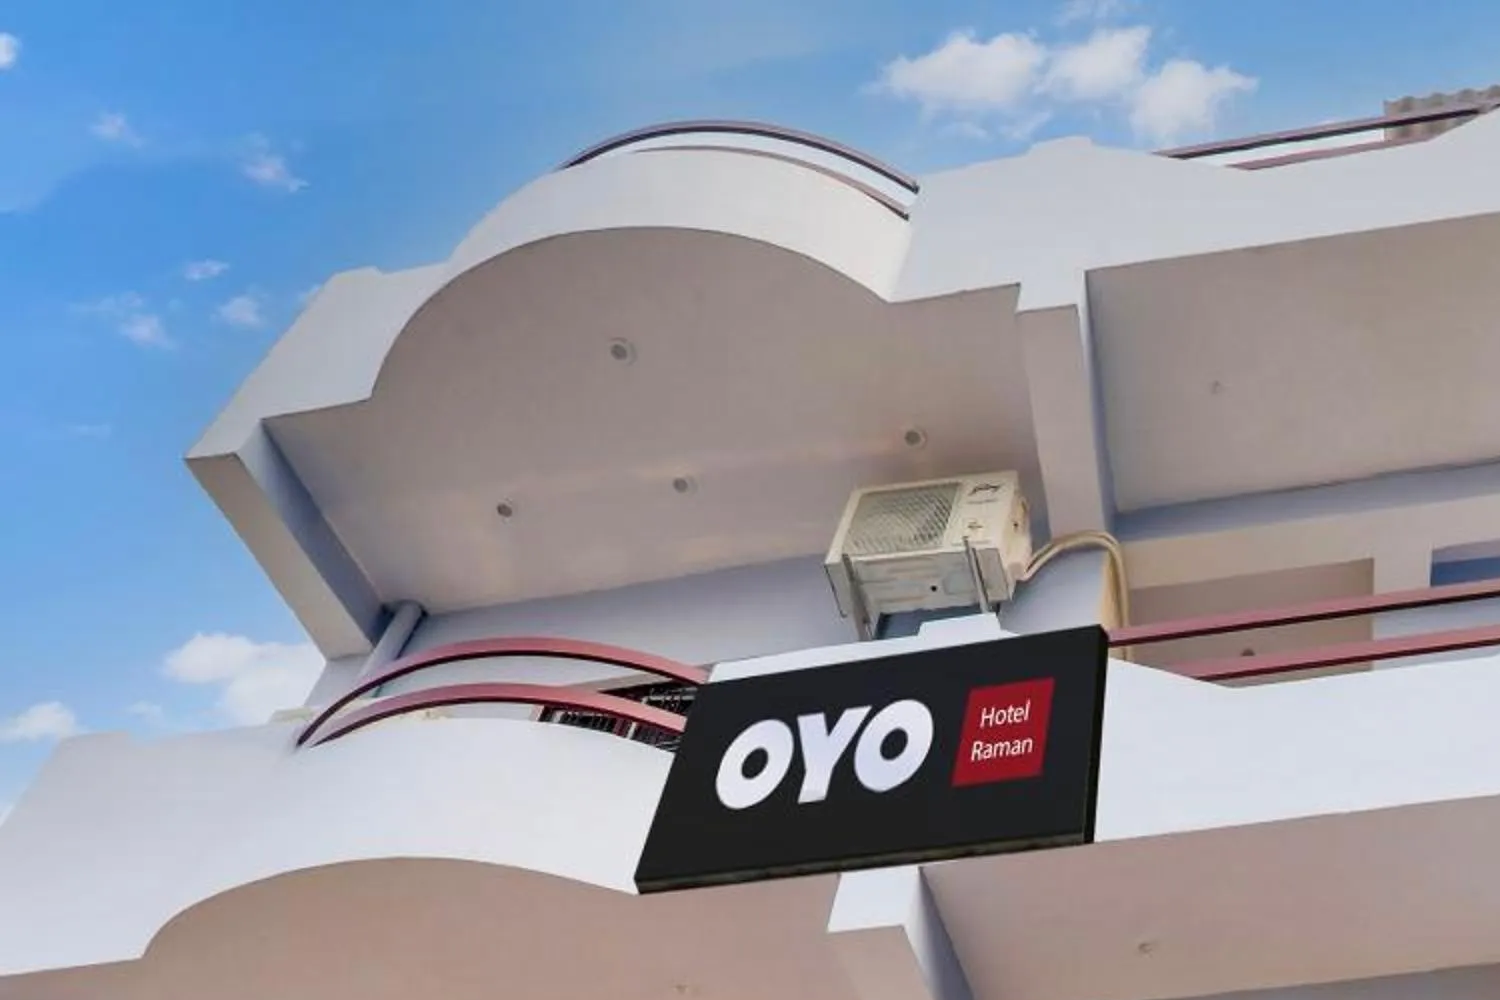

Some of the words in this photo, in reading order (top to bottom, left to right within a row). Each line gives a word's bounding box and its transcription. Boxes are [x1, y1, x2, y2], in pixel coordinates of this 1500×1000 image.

[980, 700, 1031, 727] Hotel
[715, 699, 934, 810] OYO
[971, 737, 1033, 761] Raman
